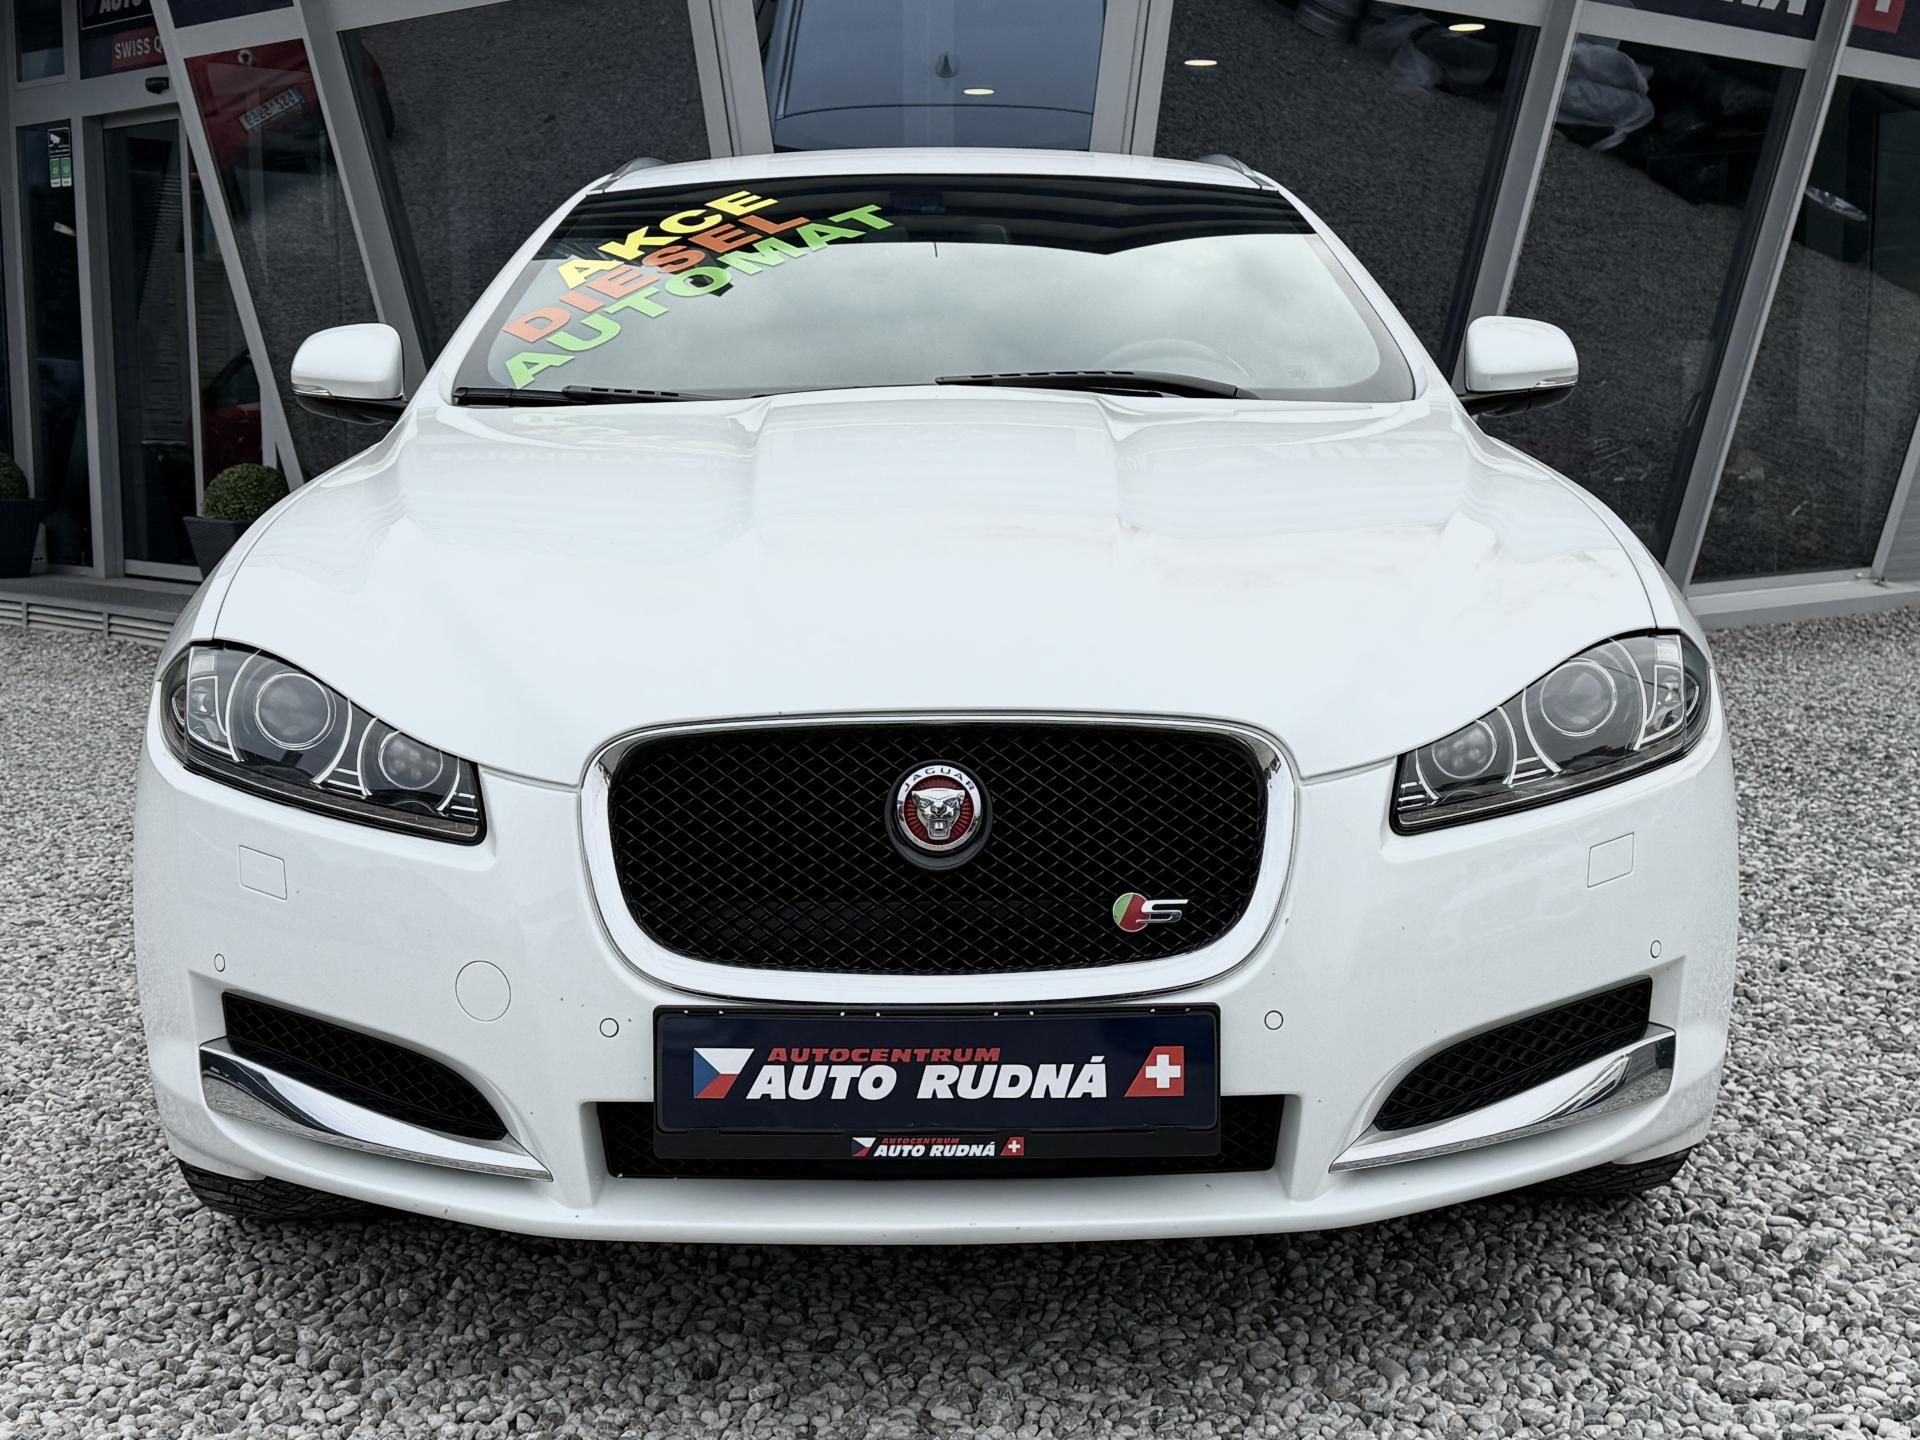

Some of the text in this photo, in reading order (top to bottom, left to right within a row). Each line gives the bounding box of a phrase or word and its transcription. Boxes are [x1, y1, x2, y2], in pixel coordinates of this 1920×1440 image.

[114, 38, 150, 60] SWISS
[556, 190, 779, 289] AKCE
[502, 214, 811, 344] DIESEL
[505, 204, 895, 389] AUTOMAT
[904, 767, 976, 793] JAGUAR
[767, 1047, 1001, 1063] AUTOCENTRUM
[746, 1055, 1108, 1101] AUTO RUDNÁ
[873, 1141, 996, 1157] AUTO RUDNÁ
[881, 1137, 960, 1145] AUTOCENTRUM
